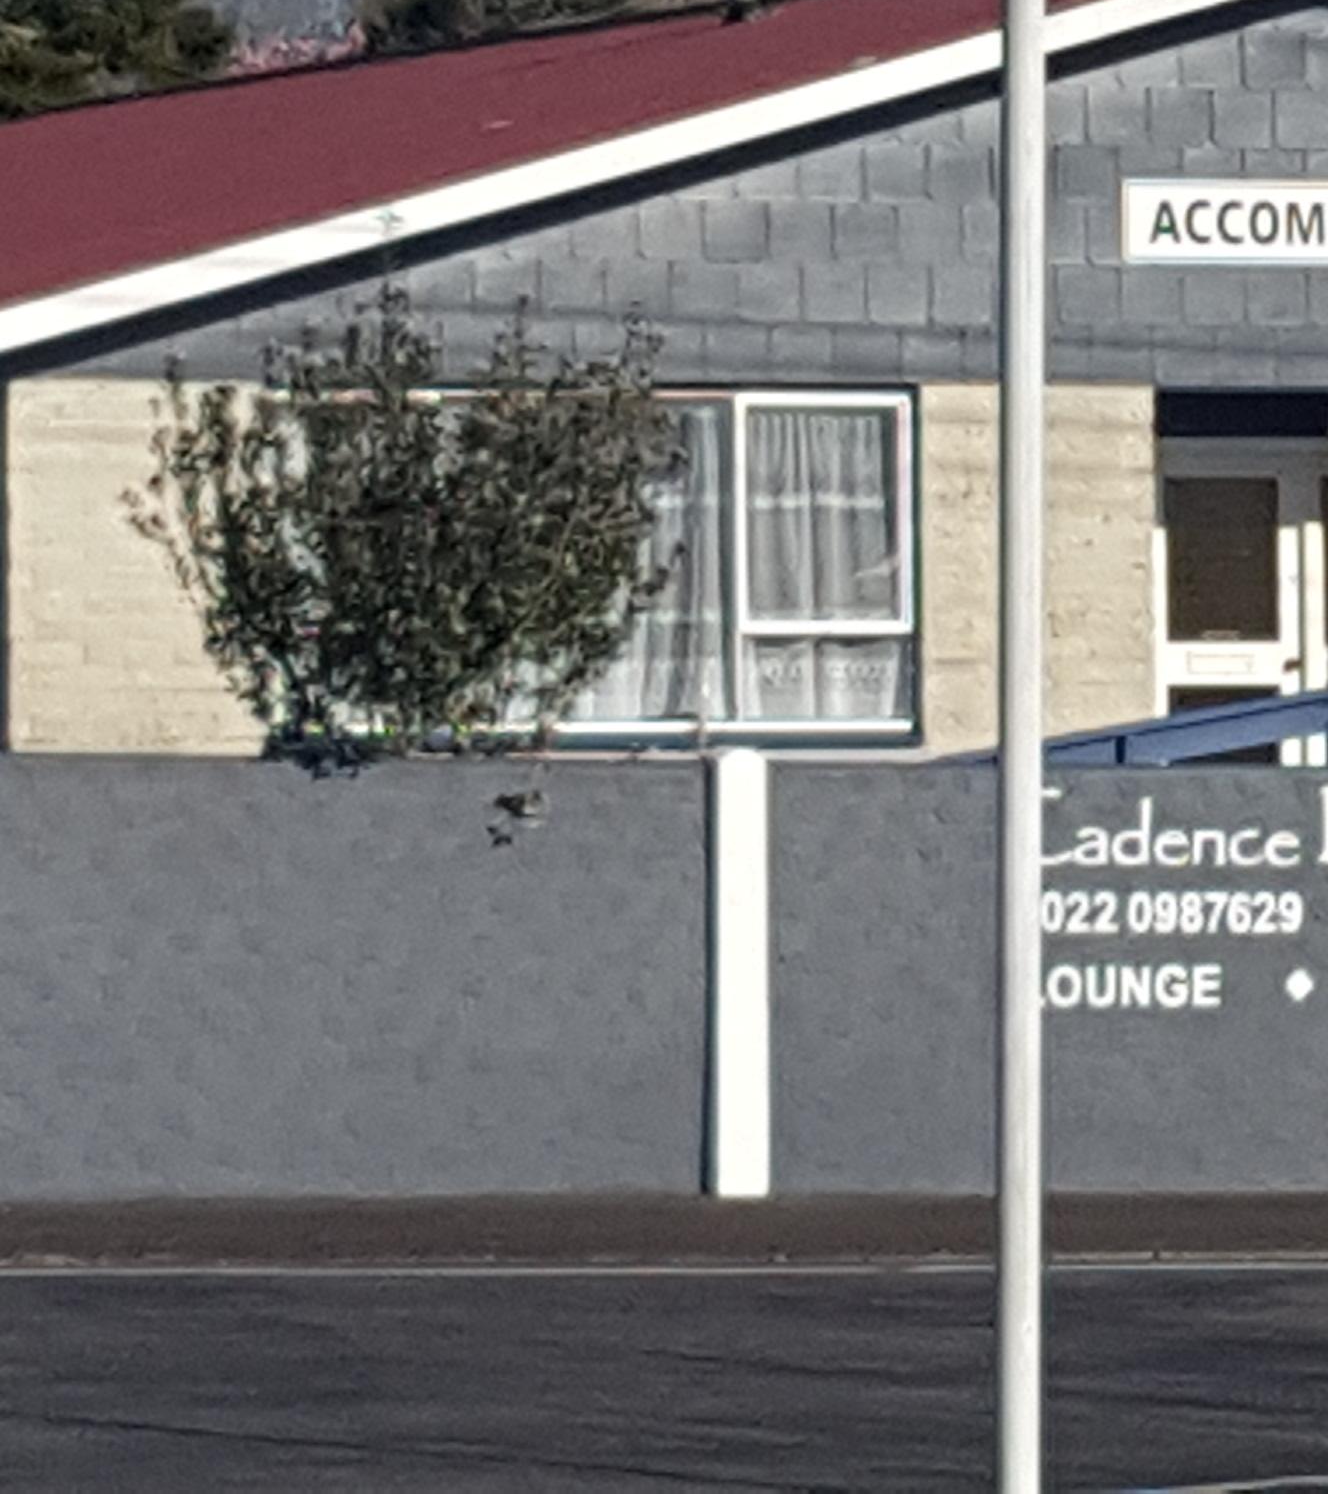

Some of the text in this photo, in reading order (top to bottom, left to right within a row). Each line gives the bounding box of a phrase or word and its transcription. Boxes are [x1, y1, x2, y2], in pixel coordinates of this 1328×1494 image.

[1041, 891, 1119, 933] 022
[1127, 891, 1304, 933] 0987629
[1041, 962, 1222, 1008] OUNGE
